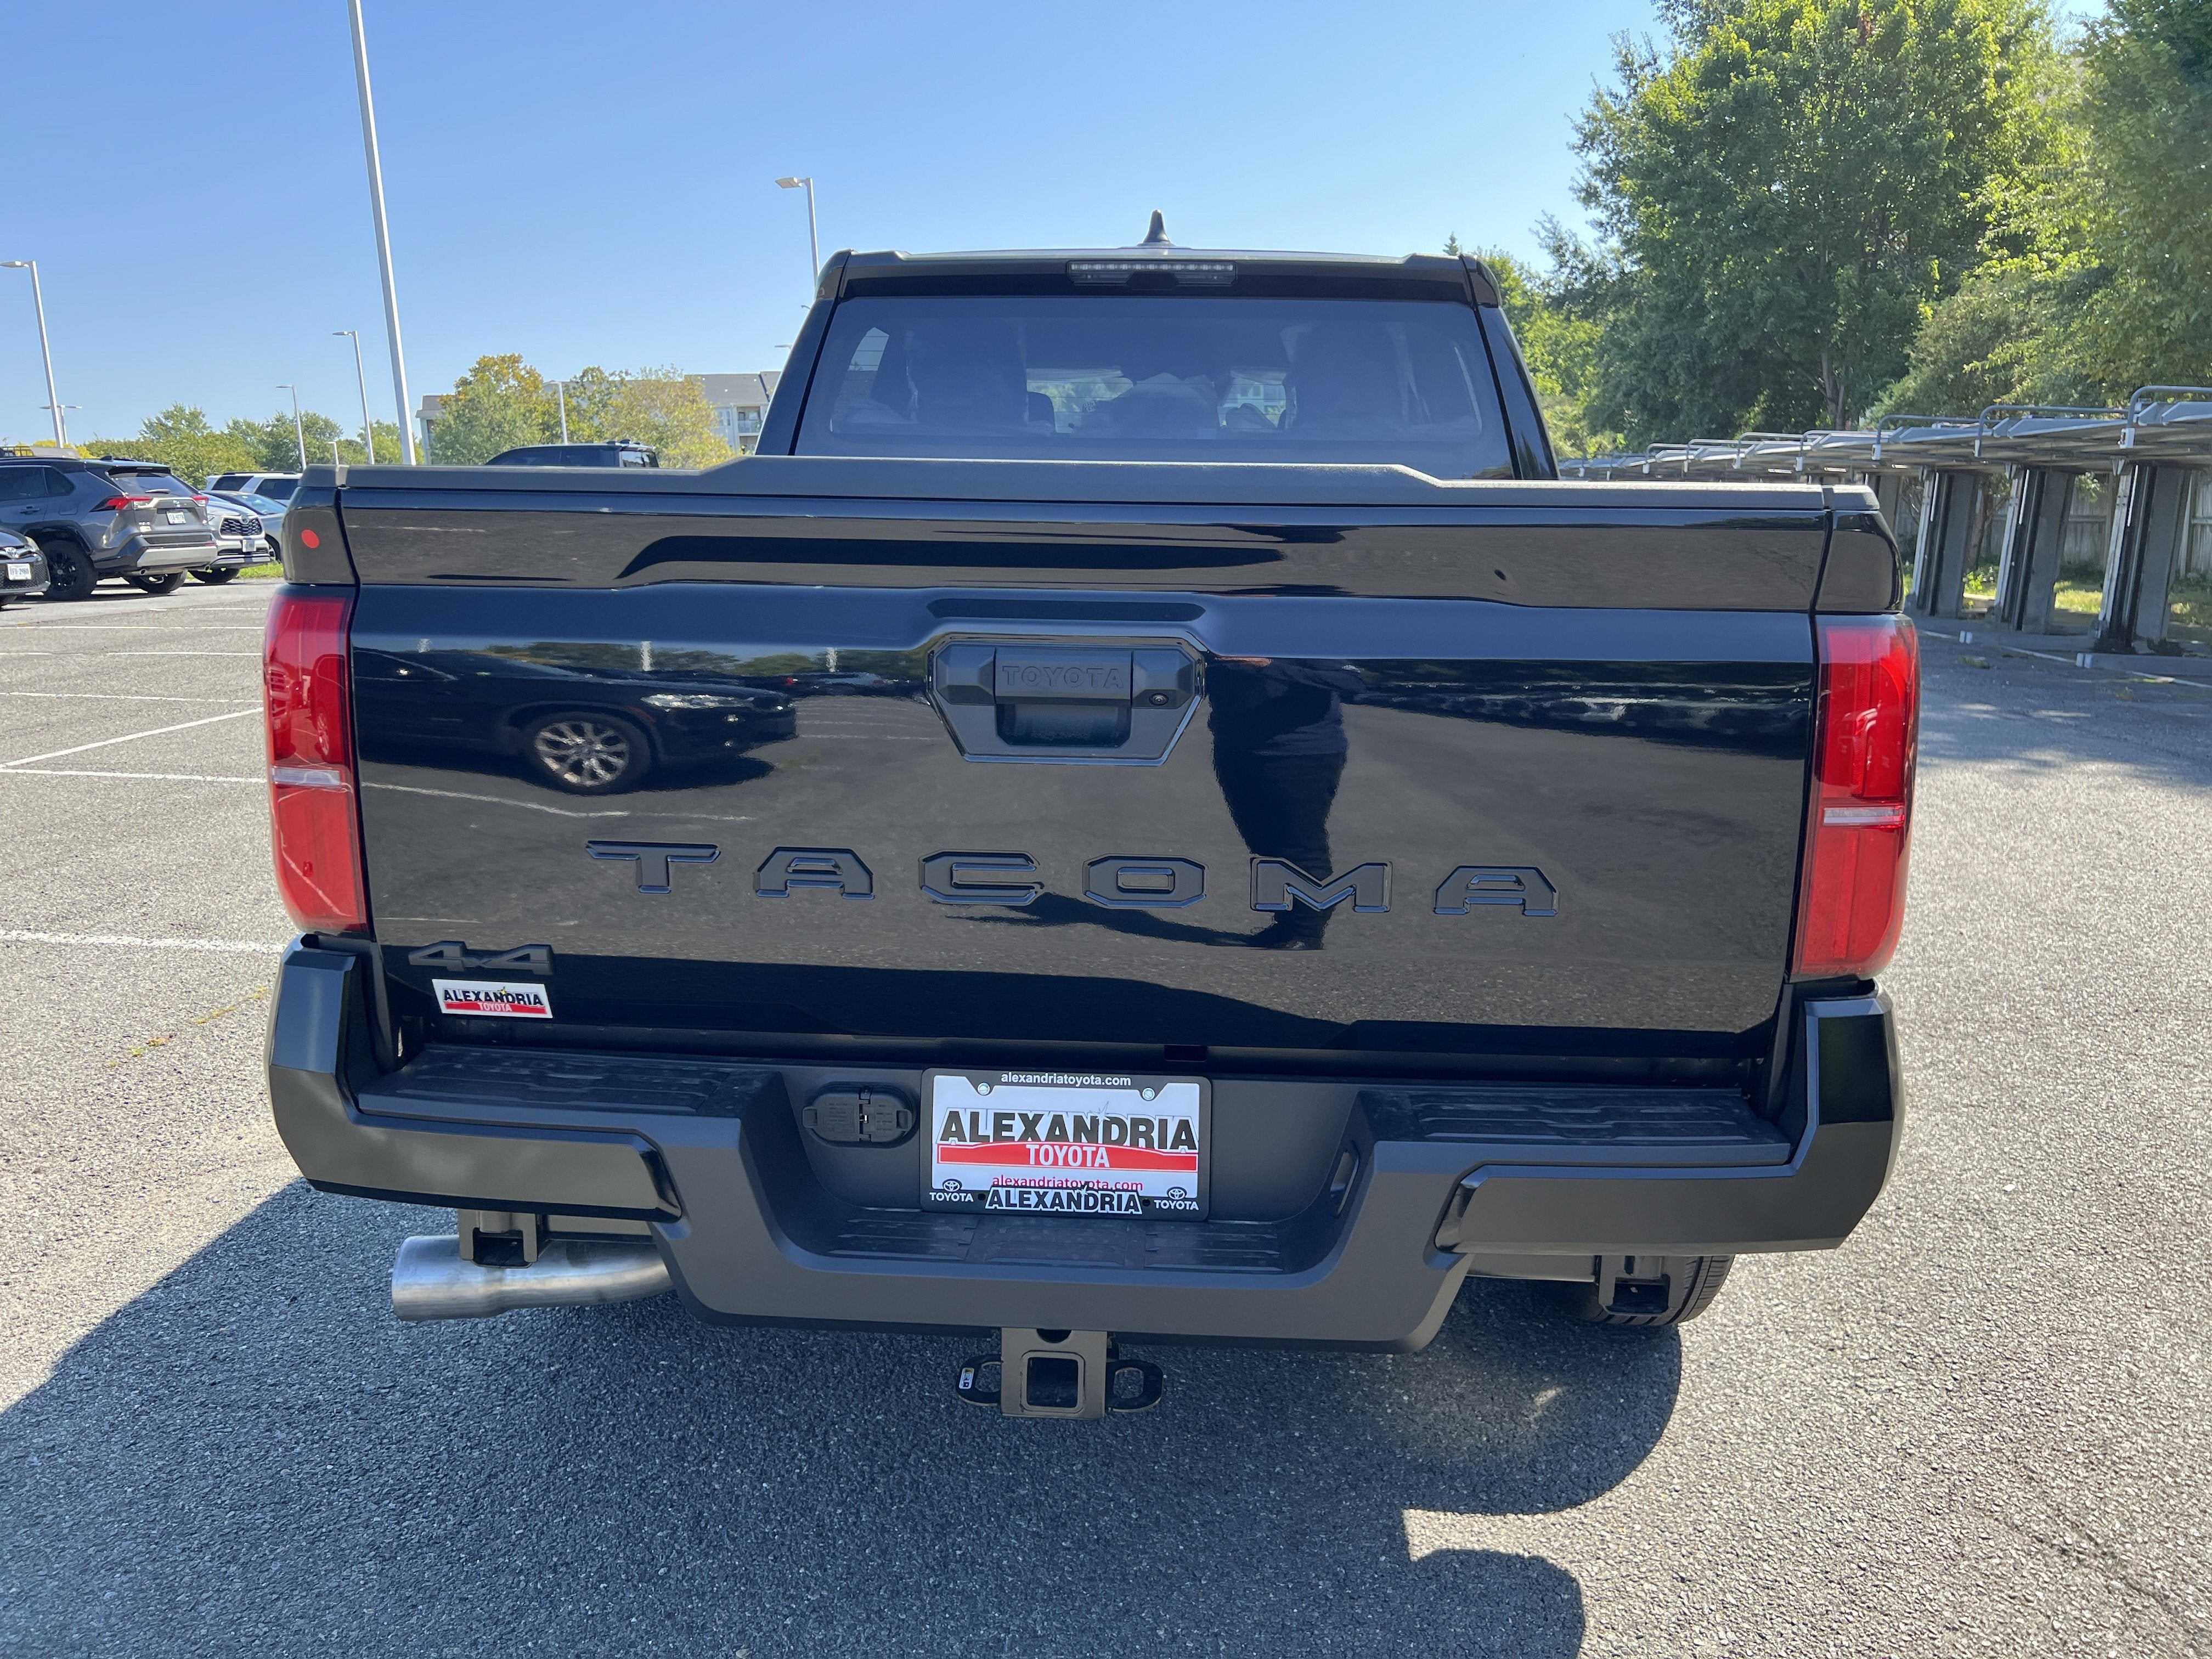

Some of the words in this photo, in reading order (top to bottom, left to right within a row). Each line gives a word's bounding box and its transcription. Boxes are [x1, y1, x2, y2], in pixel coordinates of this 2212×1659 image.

[1002, 665, 1124, 689] TOYOTA
[586, 840, 1560, 917] TACOMA
[407, 940, 554, 975] 4x4
[444, 989, 543, 1006] ALEXANDRIA
[477, 1002, 513, 1012] TOYOTA
[1001, 1071, 1132, 1086] alexandriatoyota.com
[939, 1110, 1197, 1150] ALEXANDRIA
[1025, 1143, 1110, 1168] TOYOTA
[929, 1192, 974, 1202] TOYOTA
[986, 1187, 1142, 1214] ALEXANDRIA
[1154, 1199, 1199, 1211] TOYOTA
